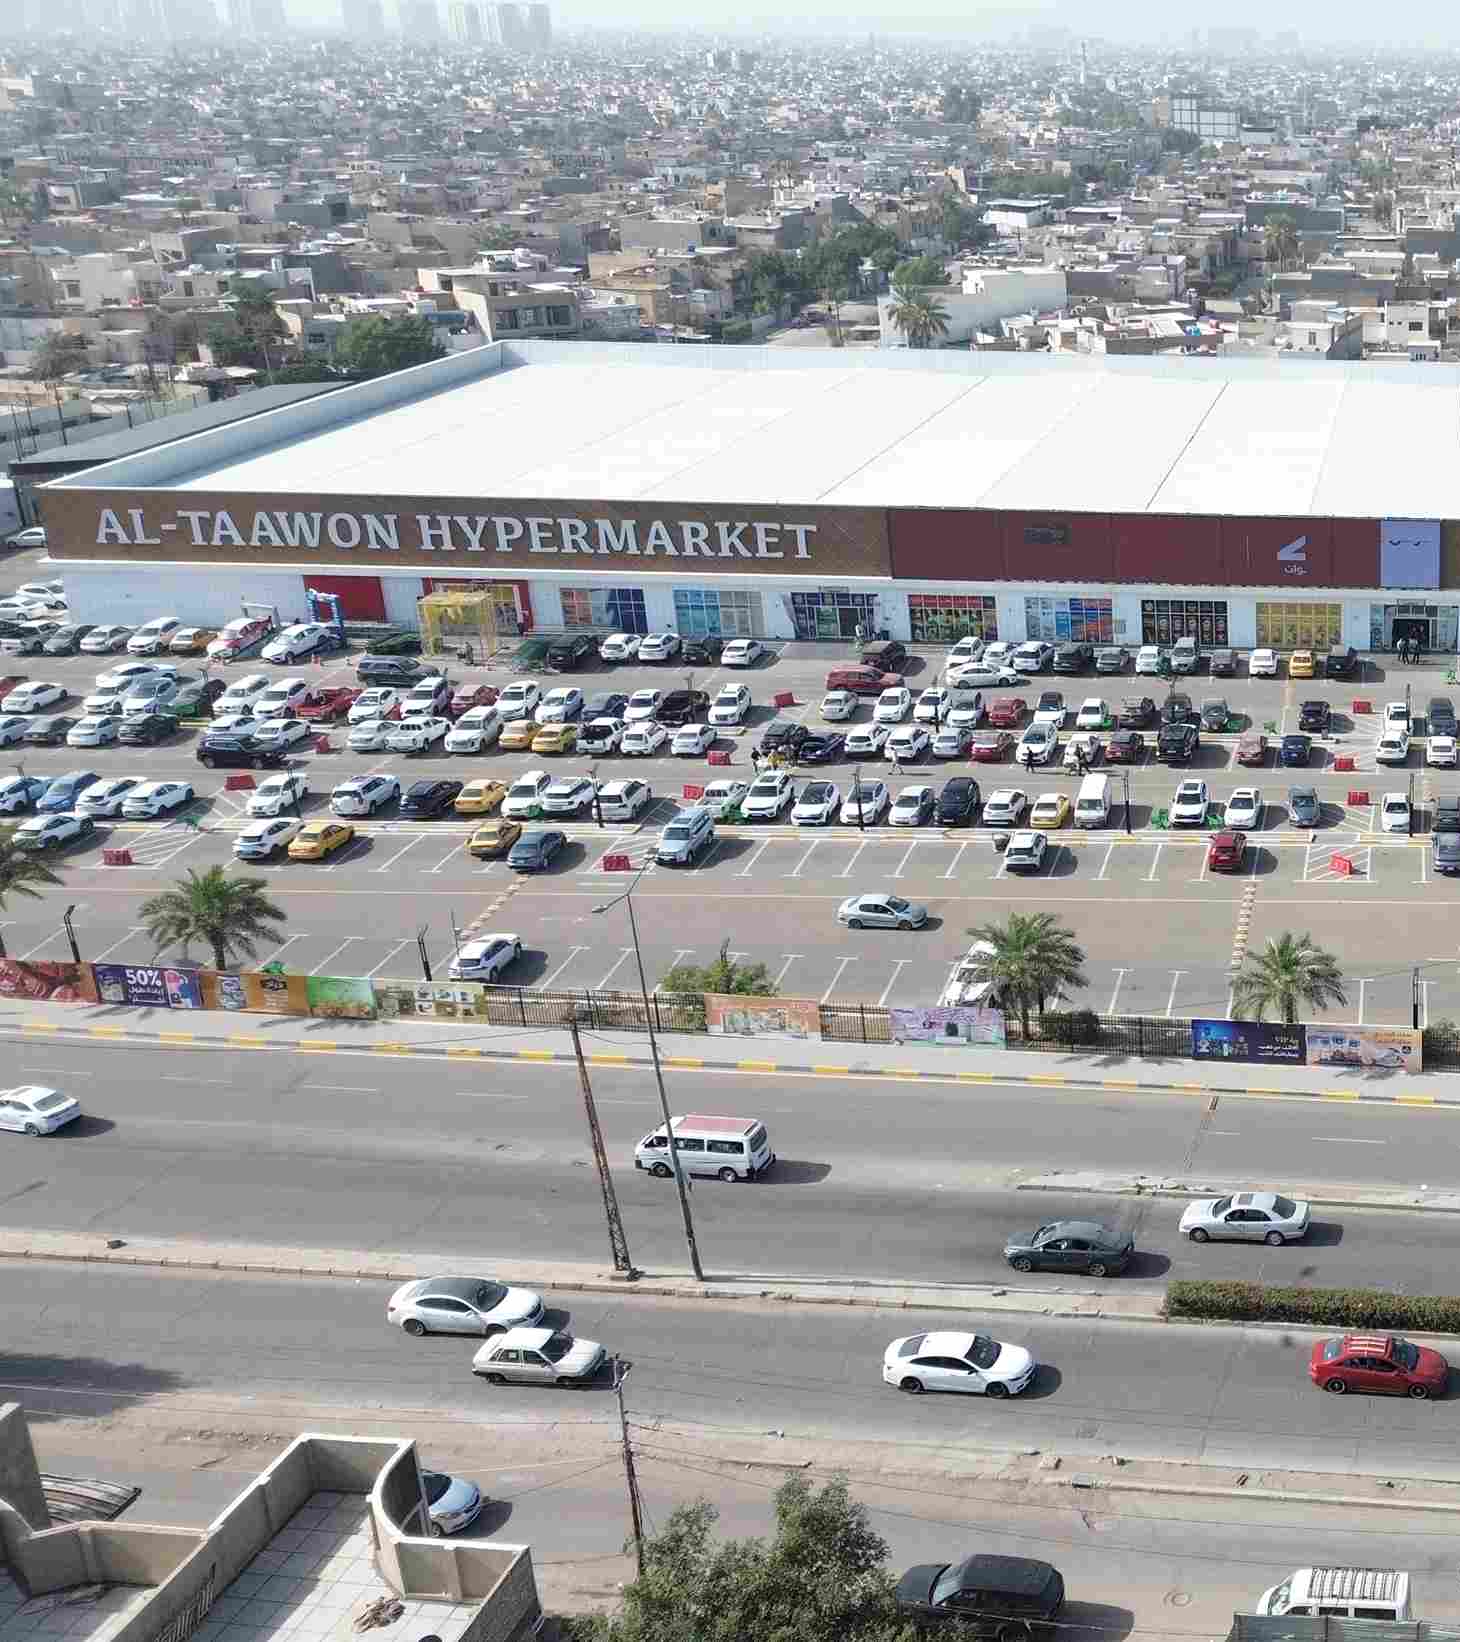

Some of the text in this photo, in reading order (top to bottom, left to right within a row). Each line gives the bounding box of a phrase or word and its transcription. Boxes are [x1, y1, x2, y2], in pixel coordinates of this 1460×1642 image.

[96, 508, 817, 559] AL-TAAWON HYPERMARKET
[125, 969, 162, 987] 50%
